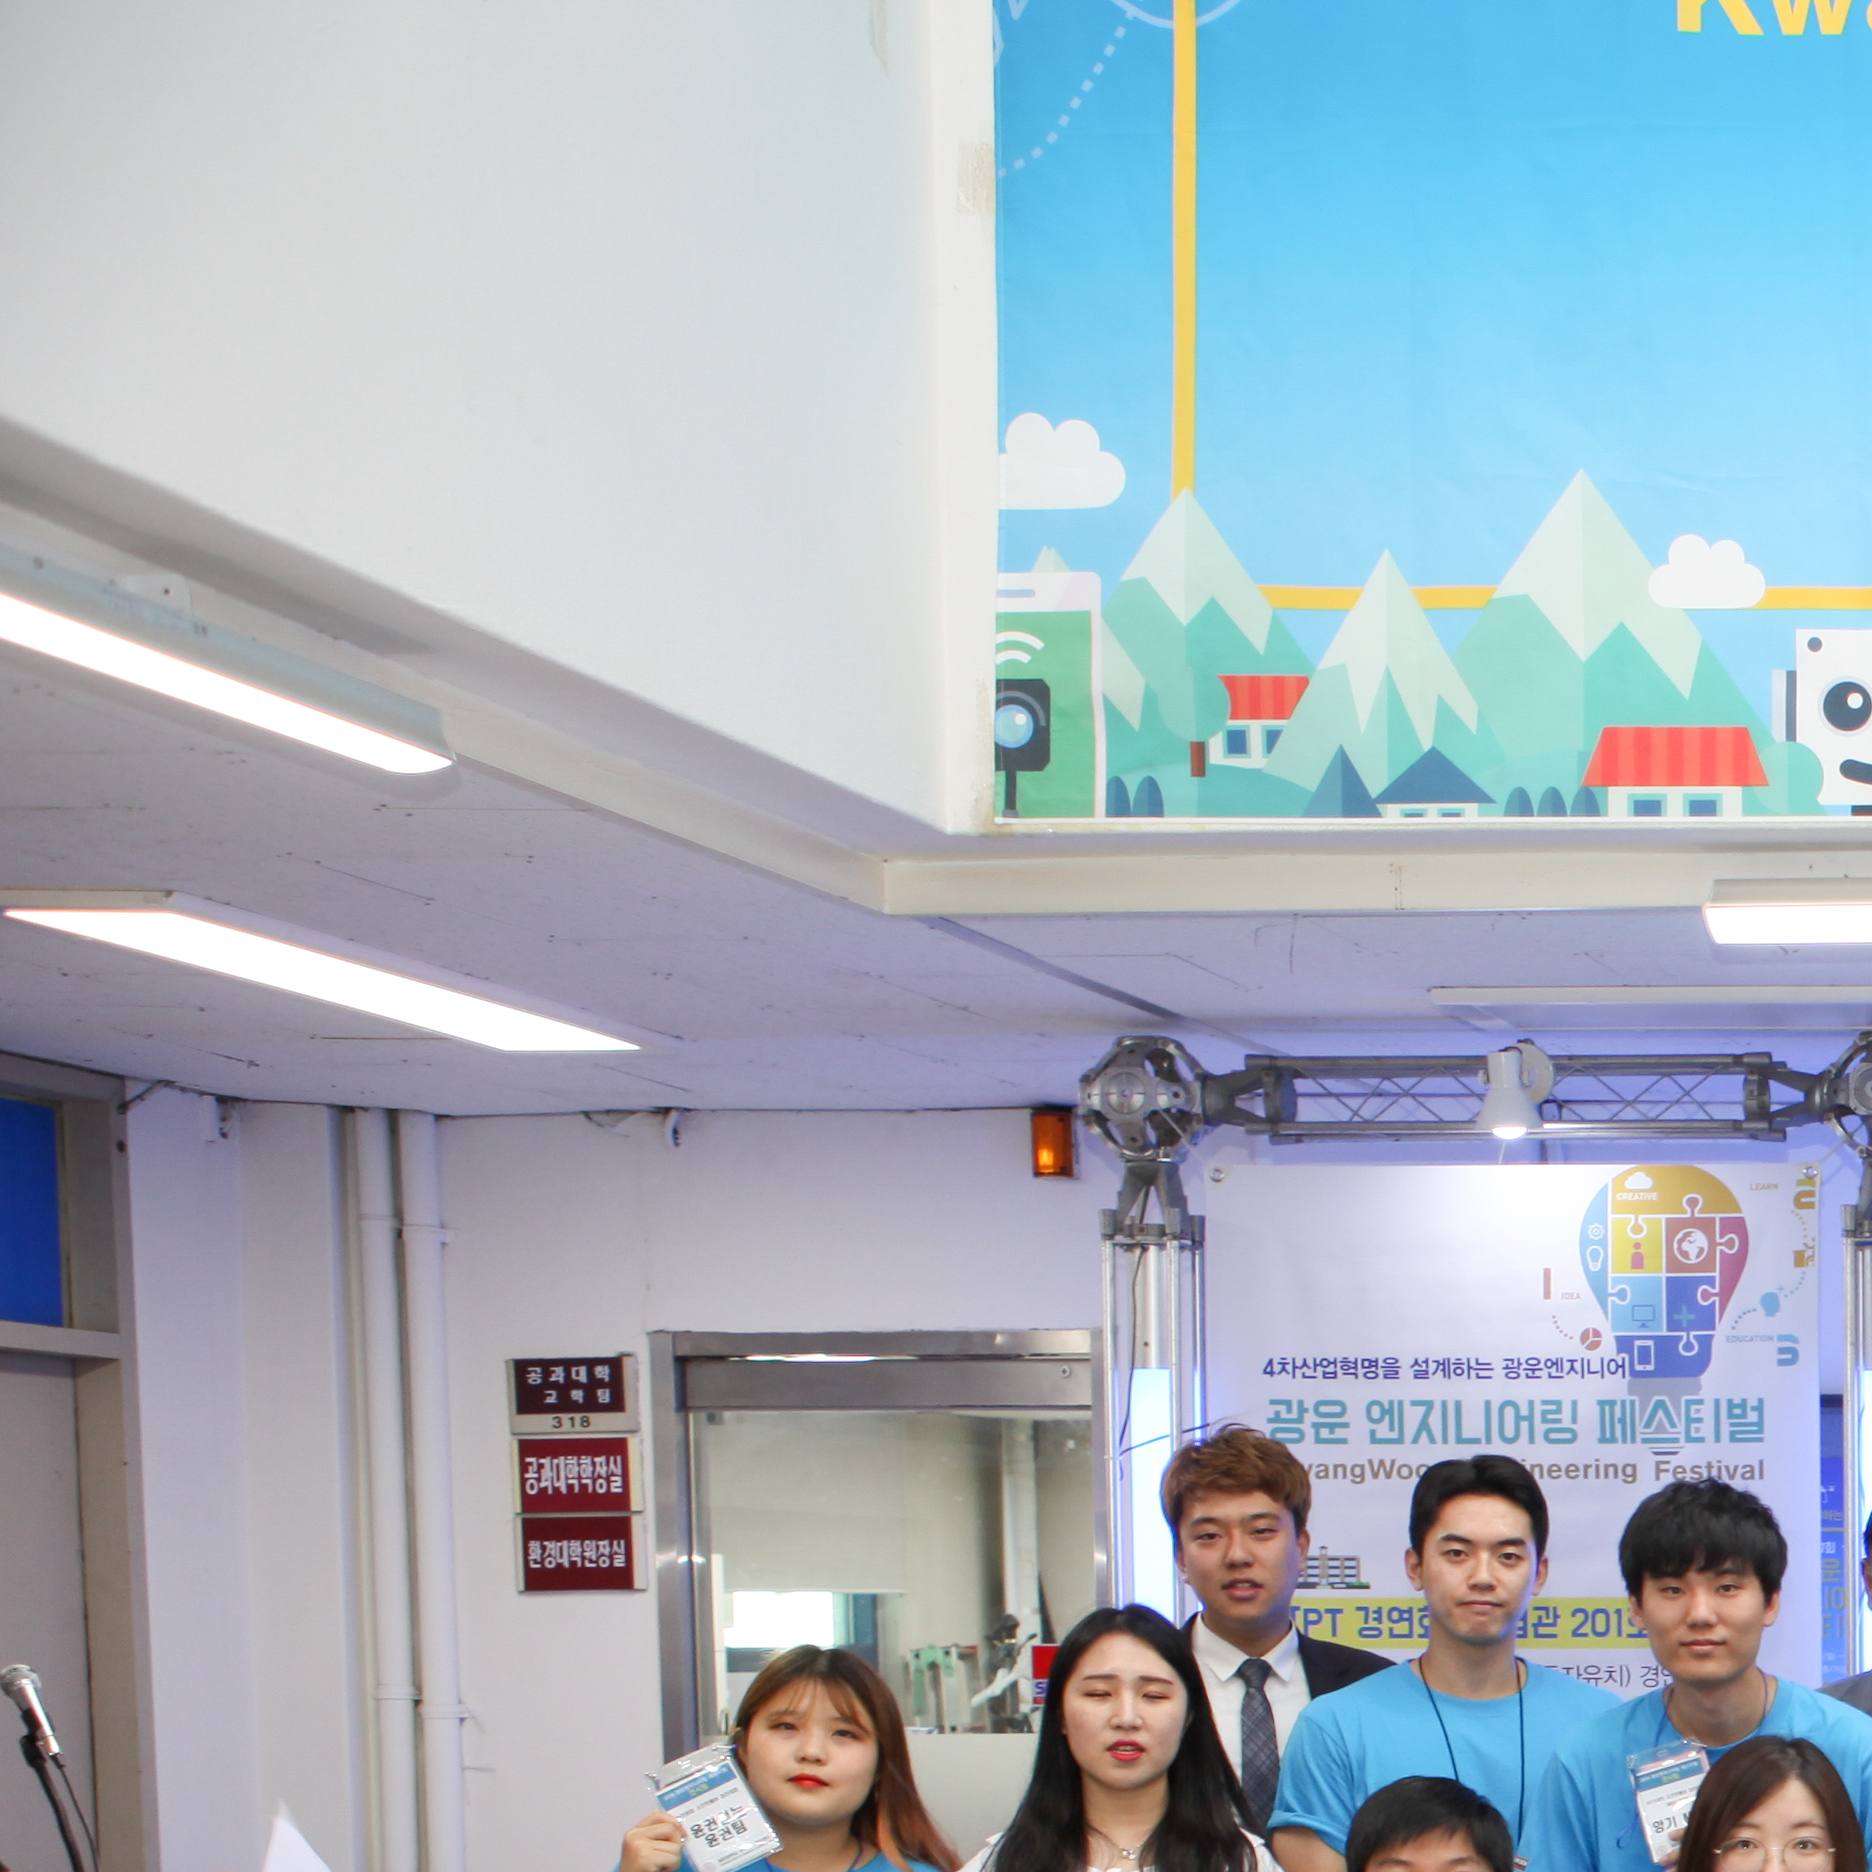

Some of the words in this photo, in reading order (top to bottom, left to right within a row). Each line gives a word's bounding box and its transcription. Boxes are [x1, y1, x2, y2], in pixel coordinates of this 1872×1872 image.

[1616, 1192, 1658, 1201] CREATIVE
[1725, 1335, 1774, 1343] EDUCATION
[1262, 1356, 1402, 1381] 4차산업혁명을
[1409, 1356, 1495, 1381] 설계하는
[1501, 1356, 1627, 1380] 광운엔지니어
[552, 1416, 591, 1429] 318
[1265, 1398, 1348, 1445] 광운
[1365, 1398, 1579, 1445] 엔지니어링
[1597, 1397, 1767, 1445] 페스티벌
[524, 1455, 624, 1495] 공과대학학장실
[1654, 1459, 1765, 1482] Festival
[527, 1540, 626, 1569] 환경대학원장실
